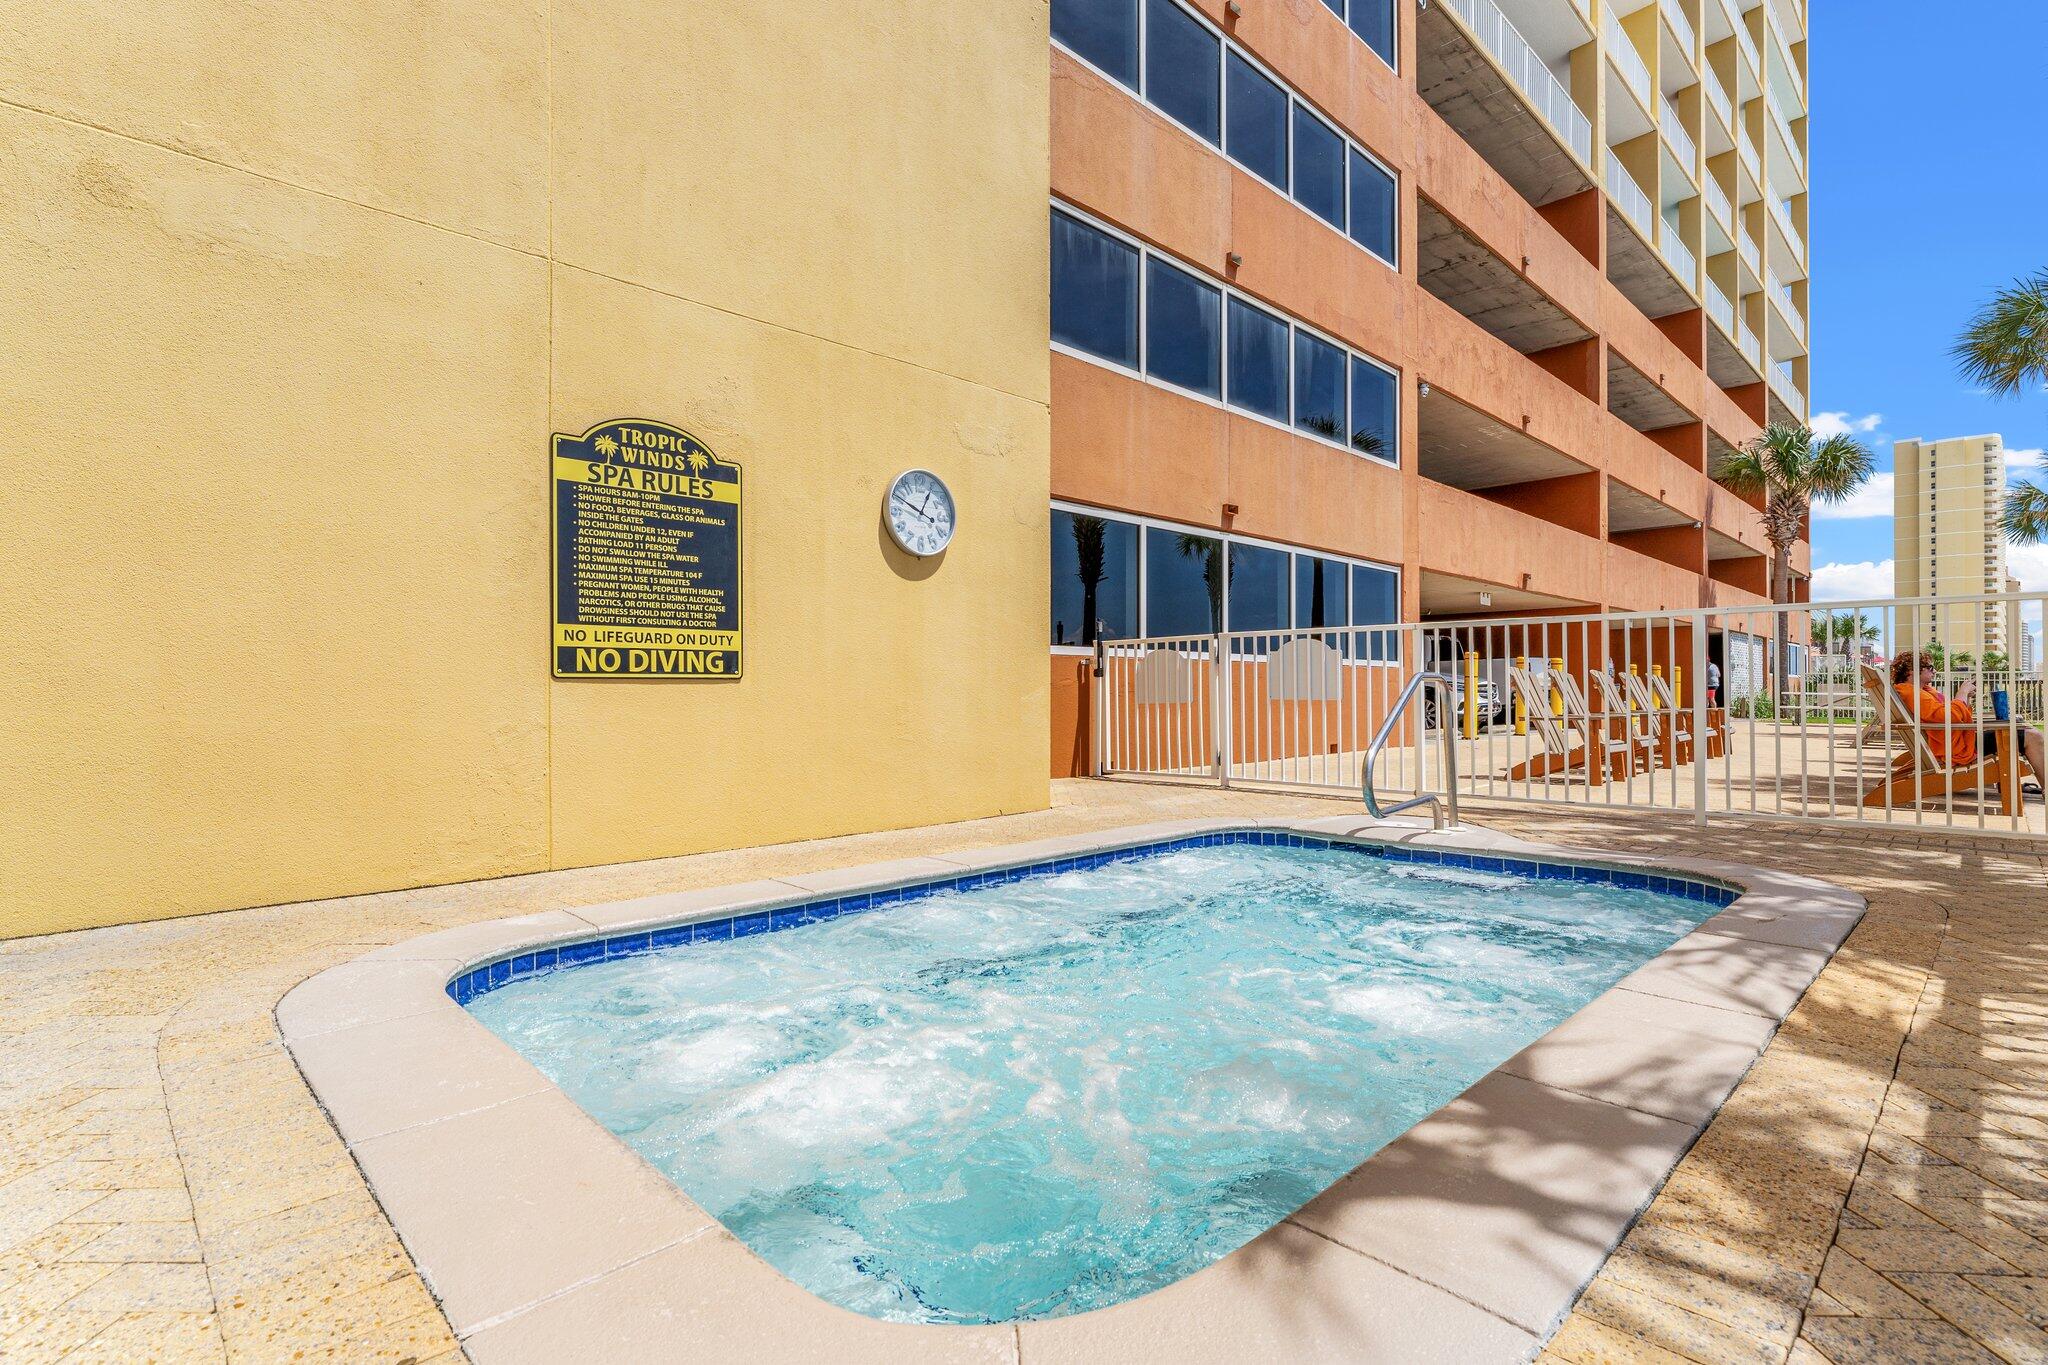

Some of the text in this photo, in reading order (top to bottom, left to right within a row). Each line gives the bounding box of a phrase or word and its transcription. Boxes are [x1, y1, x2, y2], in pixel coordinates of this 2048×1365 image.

[618, 427, 687, 454] TROPIC
[621, 446, 686, 471] WINDS
[587, 463, 714, 499] SPA RULES
[594, 487, 621, 496] HOURS
[622, 491, 660, 501] 8AM-10PM
[578, 493, 611, 503] SHOWER
[613, 498, 640, 507] BEFORE
[642, 502, 676, 512] ENTERING
[677, 506, 690, 514] THE
[579, 511, 604, 520] INSIDE
[621, 516, 644, 524] GATES
[592, 504, 615, 513] FOOD,
[617, 507, 660, 519] BEVERAGES,
[696, 517, 726, 526] ANIMALS
[579, 528, 633, 540] ACCOMPANIED
[592, 521, 629, 531] CHILDREN
[631, 525, 655, 533] UNDER
[579, 537, 612, 546] BATHING
[614, 540, 634, 548] LOAD
[646, 544, 677, 552] PERSONS
[592, 555, 633, 566] SWIMMING
[610, 548, 646, 558] SWALLOW
[676, 555, 699, 563] WATER
[579, 563, 618, 572] MAXIMUM
[619, 566, 633, 574] SPA
[634, 568, 684, 578] TEMPERATURE
[579, 572, 618, 581] MAXIMUM
[660, 578, 690, 586] MINUTES
[579, 581, 620, 589] PREGNANT
[620, 584, 651, 592] WOMEN,
[579, 589, 619, 598] PROBLEMS
[689, 596, 721, 604] ALCOHOL,
[579, 598, 623, 607] NARCOTICS,
[579, 607, 628, 615] DROWSINESS
[578, 615, 614, 623] WITHOUT
[637, 618, 681, 626] CONSULTING
[564, 630, 734, 646] NO LIFEGUARD ON DUTY
[576, 648, 724, 673] NO DIVING
